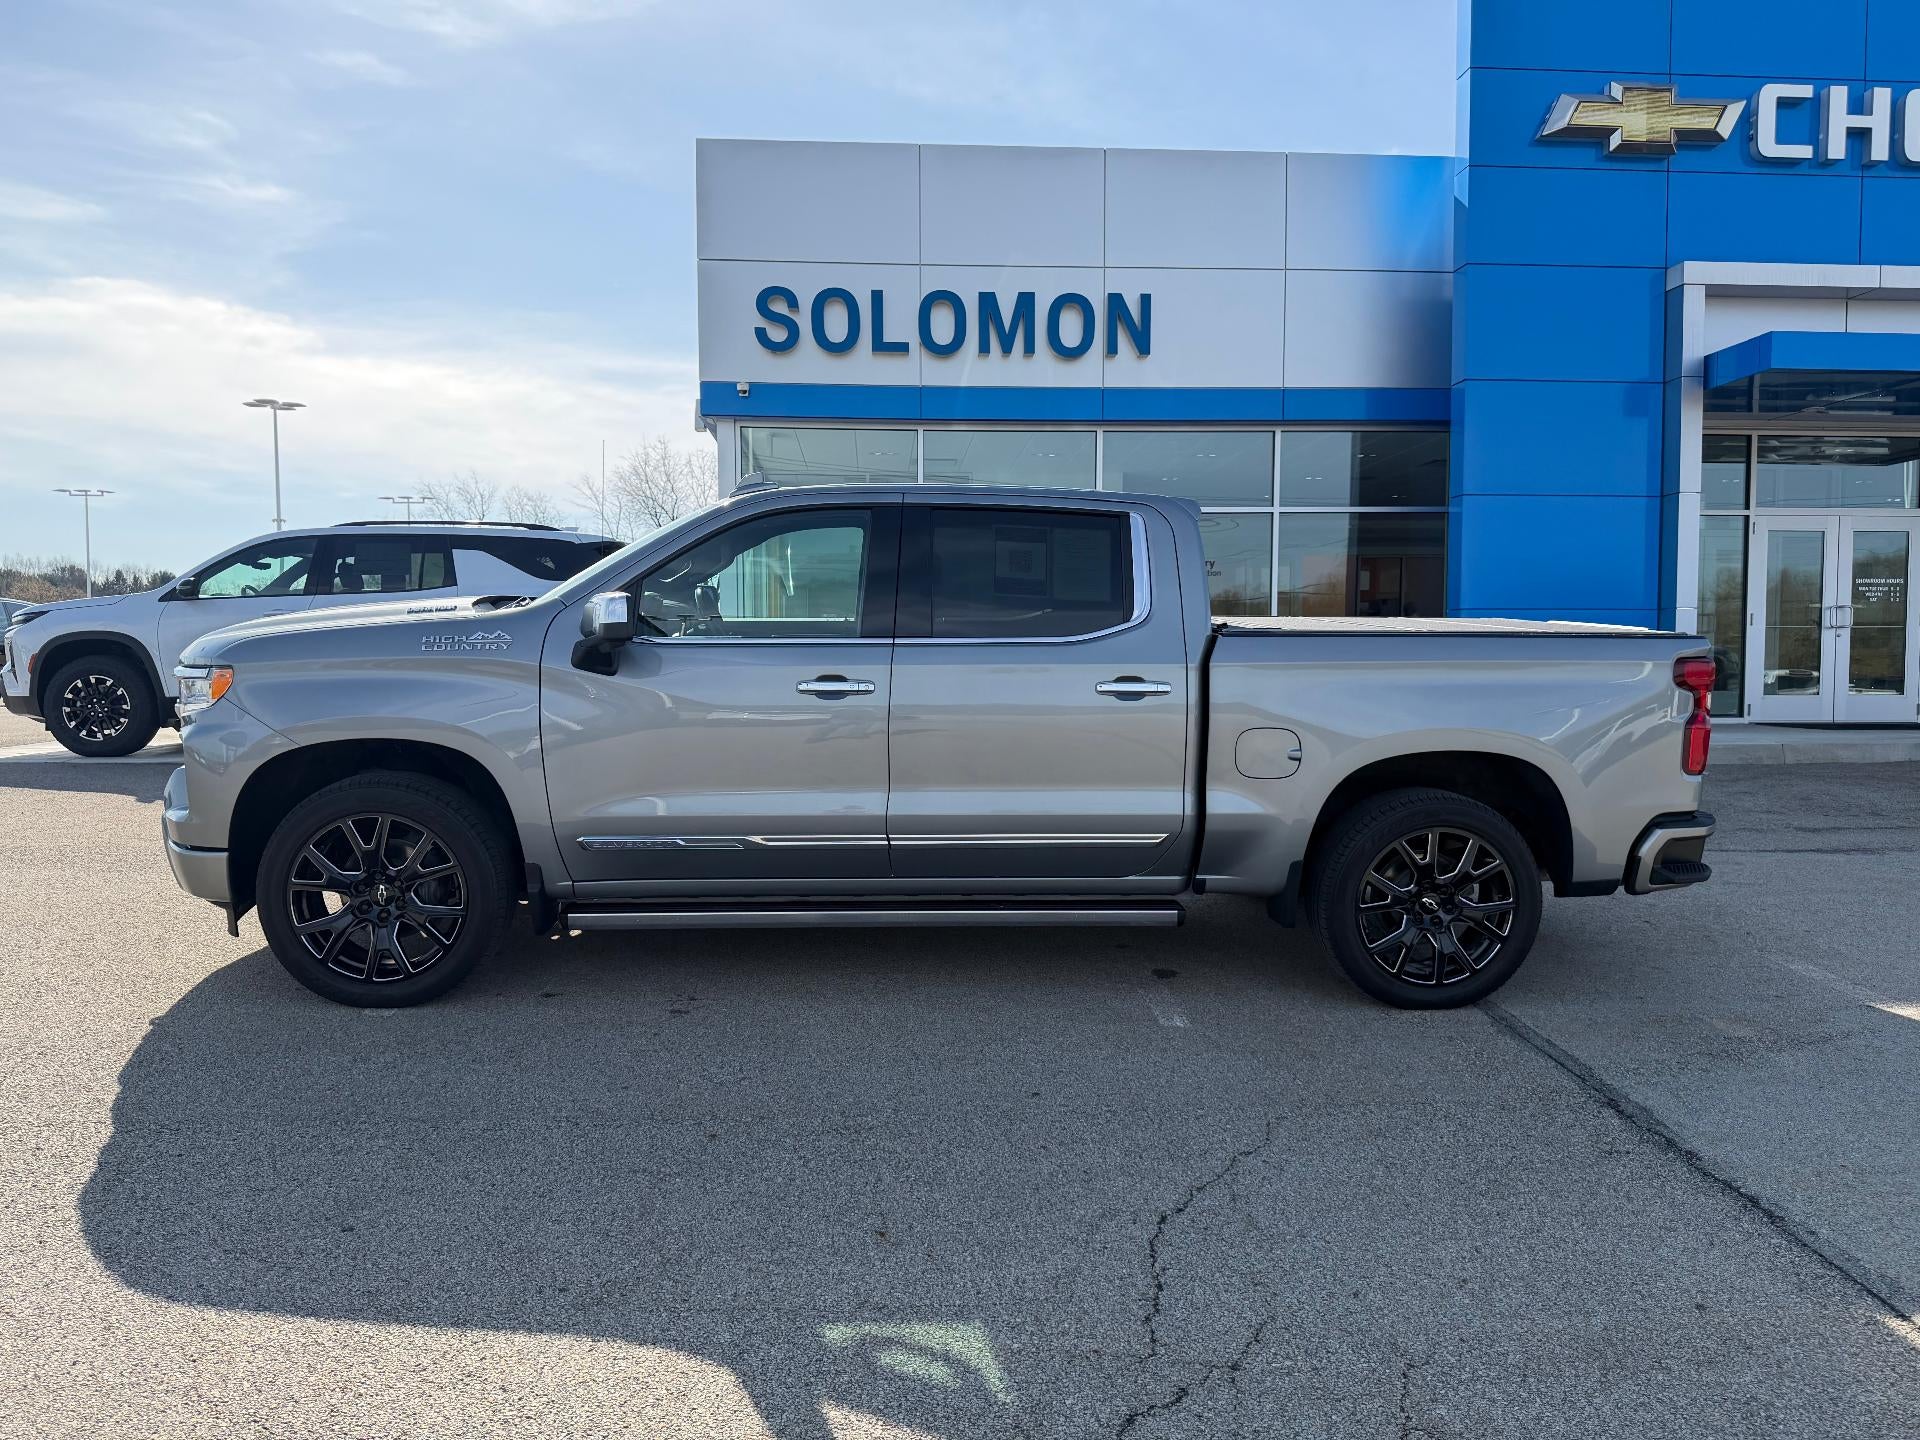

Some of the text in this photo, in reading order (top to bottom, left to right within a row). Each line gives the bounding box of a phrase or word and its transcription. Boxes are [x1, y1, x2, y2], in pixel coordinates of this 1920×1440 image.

[1751, 83, 1920, 166] CH
[754, 285, 1152, 360] SOLOMON
[421, 635, 467, 643] HIGH
[421, 643, 512, 651] COUNTRY
